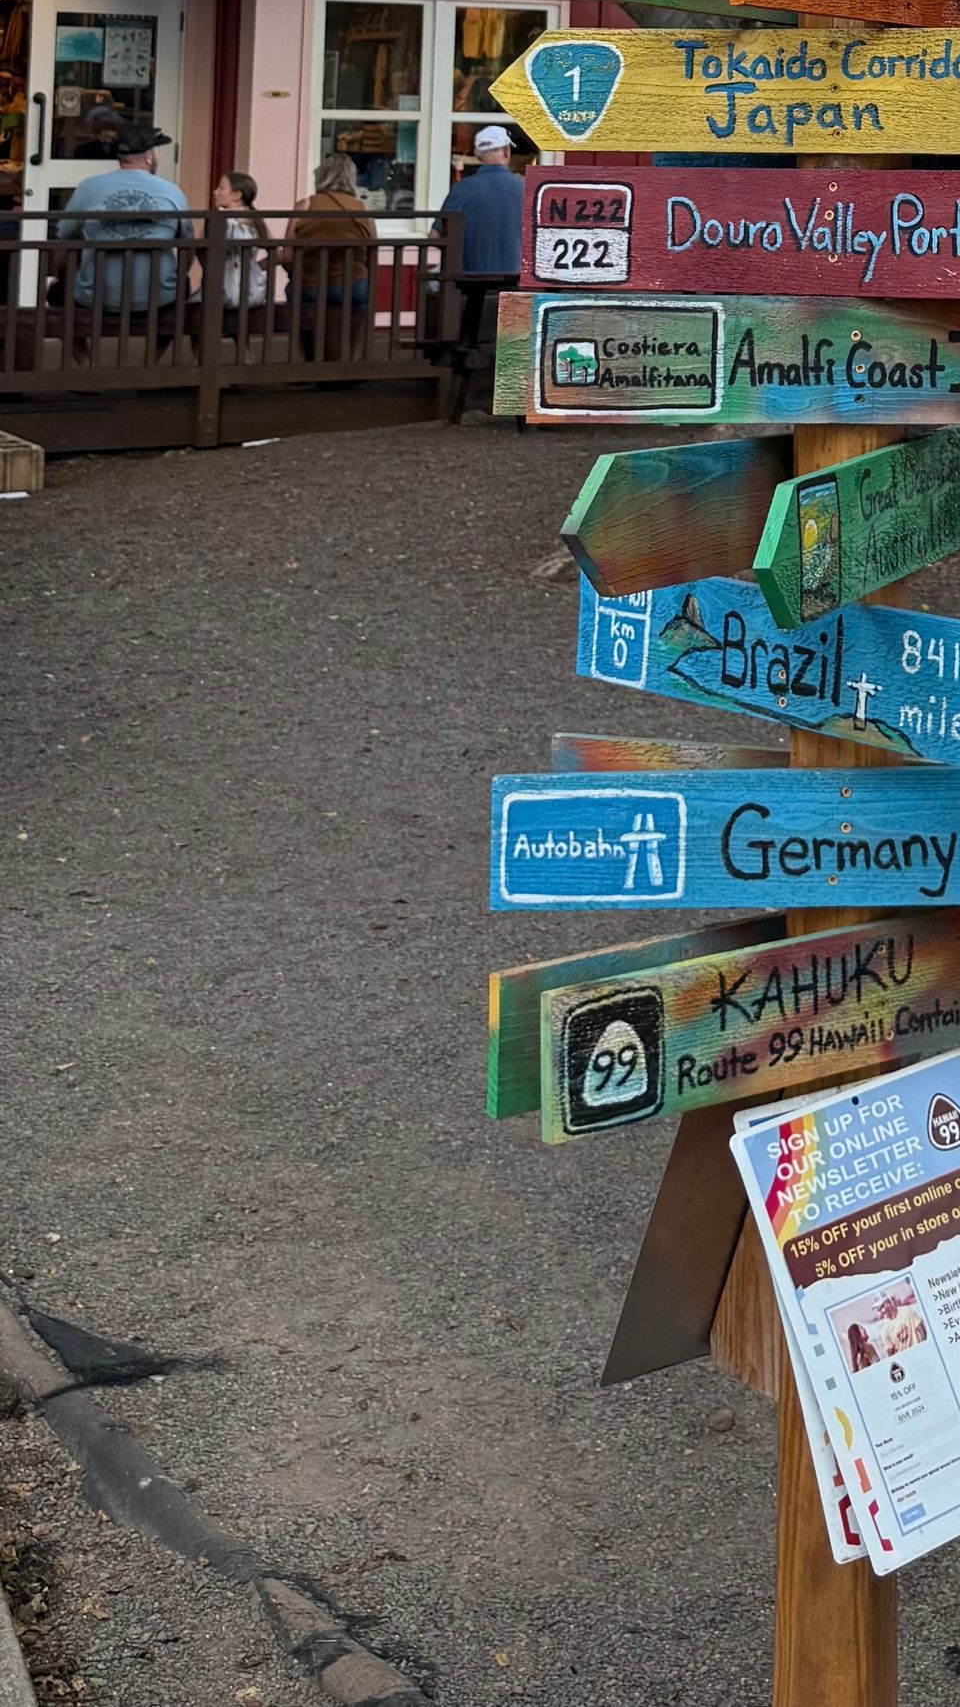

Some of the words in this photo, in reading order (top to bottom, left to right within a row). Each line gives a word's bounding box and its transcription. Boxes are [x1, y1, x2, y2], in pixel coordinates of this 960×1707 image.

[564, 65, 582, 102] 1
[674, 40, 828, 81] Tokaido
[705, 82, 883, 147] Japan
[549, 198, 567, 222] N
[574, 198, 625, 222] 222
[665, 196, 784, 252] Douro
[784, 197, 887, 283] Valley
[552, 238, 615, 270] 222
[598, 367, 713, 389] Amalfitana
[602, 336, 701, 357] Costiera
[728, 327, 835, 387] Amalfi
[846, 337, 946, 390] Coast
[610, 612, 635, 640] km
[721, 609, 844, 707] Brazil
[513, 828, 626, 860] Autobahn
[720, 802, 958, 897] Germany
[711, 934, 914, 1031] KAHUKU
[592, 1044, 638, 1091] 99
[677, 1045, 759, 1096] Route
[768, 1027, 805, 1067] 99
[767, 1125, 821, 1160] SIGN
[824, 1114, 853, 1138] UP
[858, 1094, 905, 1125] FOR
[776, 1152, 827, 1182] OUR
[829, 1116, 910, 1160] ONLINE
[939, 1121, 960, 1144] 99
[776, 1136, 923, 1207] NEWSLETTER
[789, 1203, 821, 1226] TO
[824, 1161, 925, 1214] RECEIVE:
[790, 1238, 820, 1259] 15%
[821, 1222, 850, 1246] OFF
[851, 1212, 882, 1237] your
[883, 1197, 912, 1221] first
[912, 1183, 953, 1208] online
[838, 1243, 867, 1268] OFF
[868, 1233, 899, 1259] your
[900, 1222, 915, 1242] in
[917, 1214, 950, 1236] store
